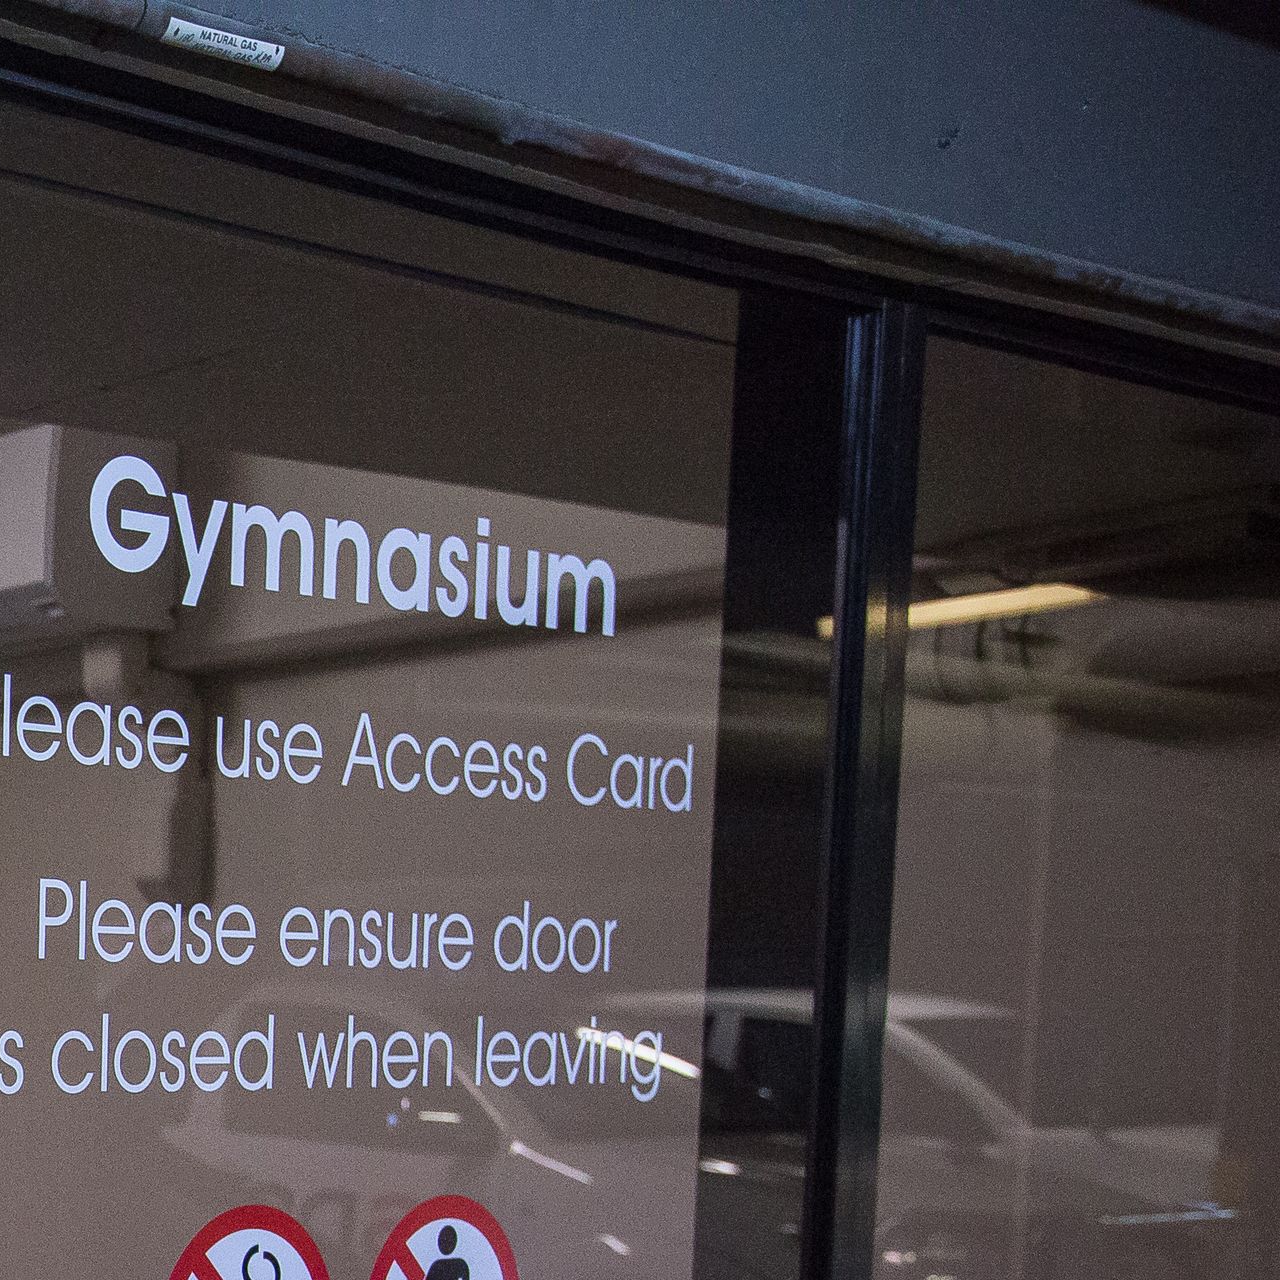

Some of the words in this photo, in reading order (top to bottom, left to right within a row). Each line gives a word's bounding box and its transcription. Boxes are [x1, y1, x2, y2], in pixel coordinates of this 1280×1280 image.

[193, 42, 234, 59] NATURAL
[234, 52, 252, 62] GAS
[200, 30, 238, 47] NATURAL
[240, 39, 258, 52] GAS
[89, 455, 616, 636] Gymnasium
[216, 716, 323, 784] use
[342, 712, 547, 802] Access
[567, 733, 694, 812] Card
[38, 878, 257, 966] Please
[279, 906, 474, 971] ensure
[493, 900, 617, 973] door
[51, 1013, 275, 1094] closed
[298, 1015, 454, 1089] when
[475, 1016, 663, 1102] leaving
